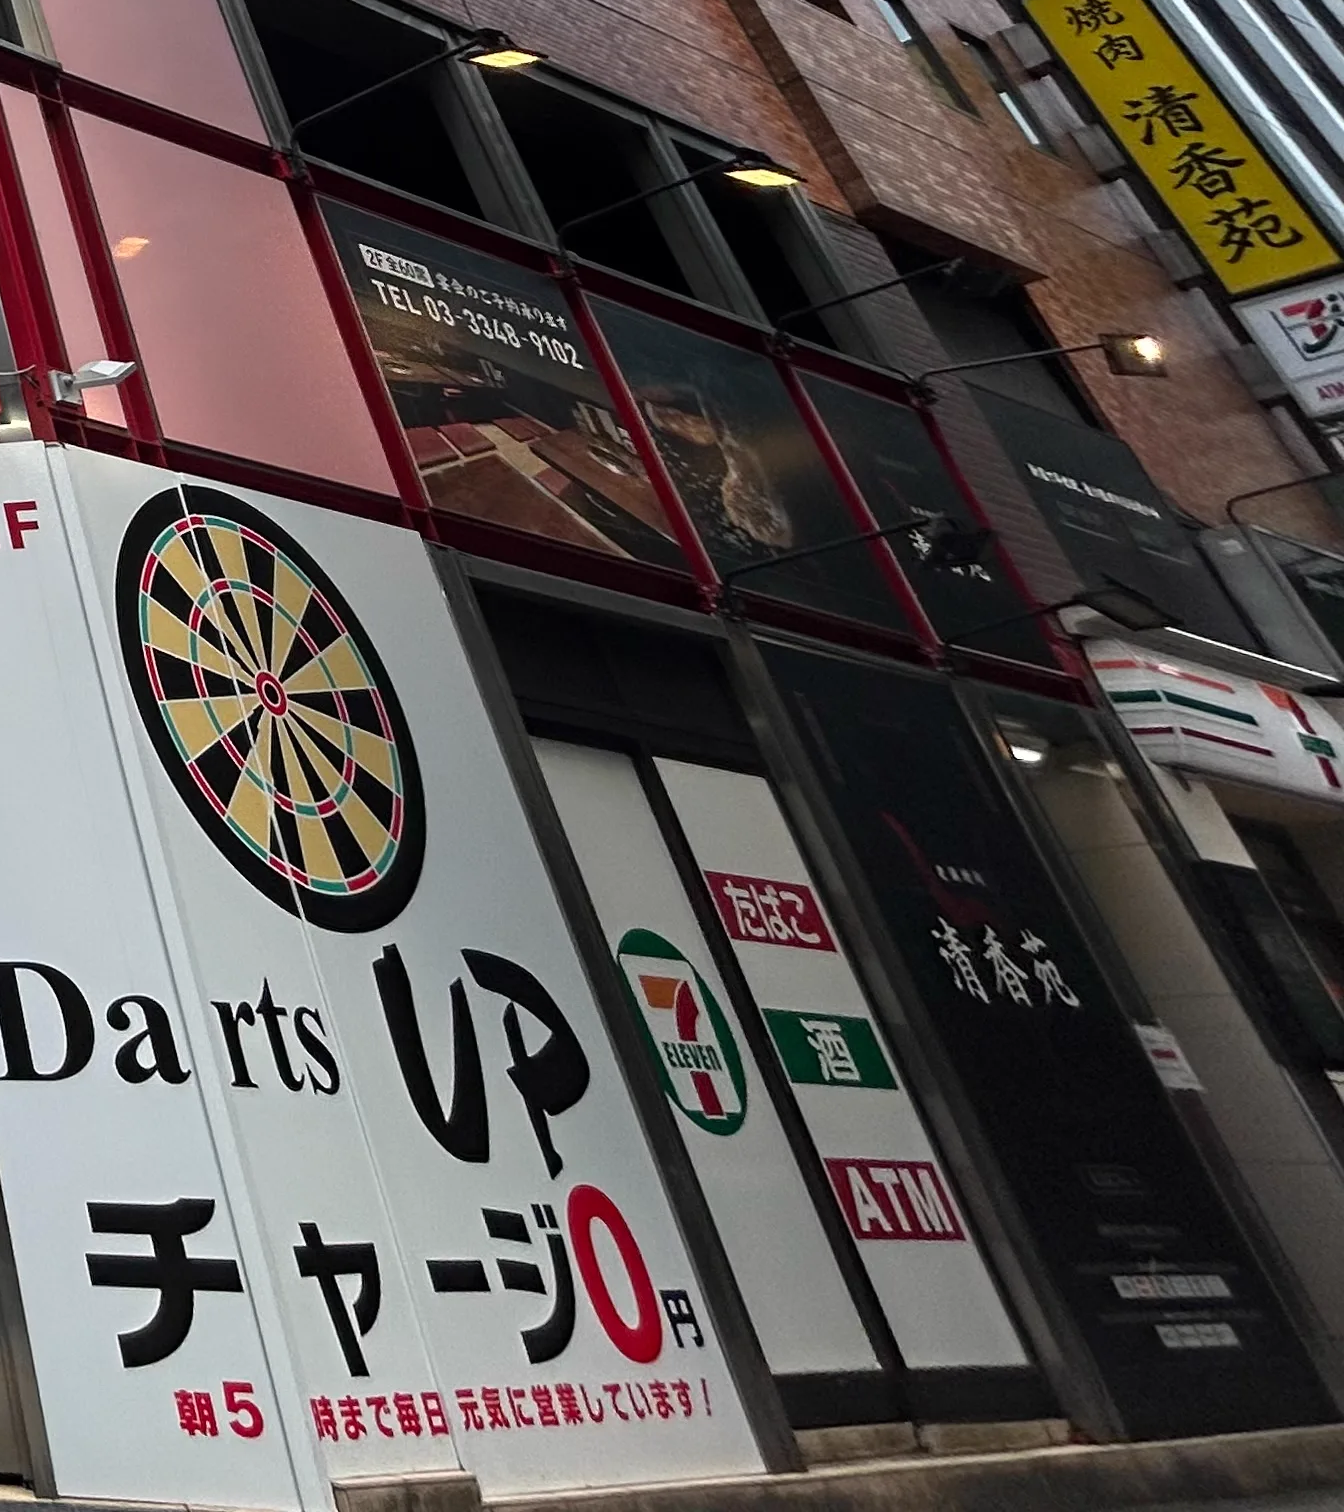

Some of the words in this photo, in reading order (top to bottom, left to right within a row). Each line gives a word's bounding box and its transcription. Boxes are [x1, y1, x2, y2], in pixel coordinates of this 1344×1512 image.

[1123, 84, 1307, 265] 清香苑
[365, 247, 386, 270] 2F
[372, 278, 422, 318] TEL
[423, 295, 585, 370] 03-3348-9102
[722, 879, 821, 945] たばこ
[930, 915, 1081, 1008] 清香苑
[370, 944, 590, 1180] UP
[661, 1040, 723, 1072] ELEVEN
[799, 1017, 860, 1082] 酒
[845, 1165, 954, 1234] ATM
